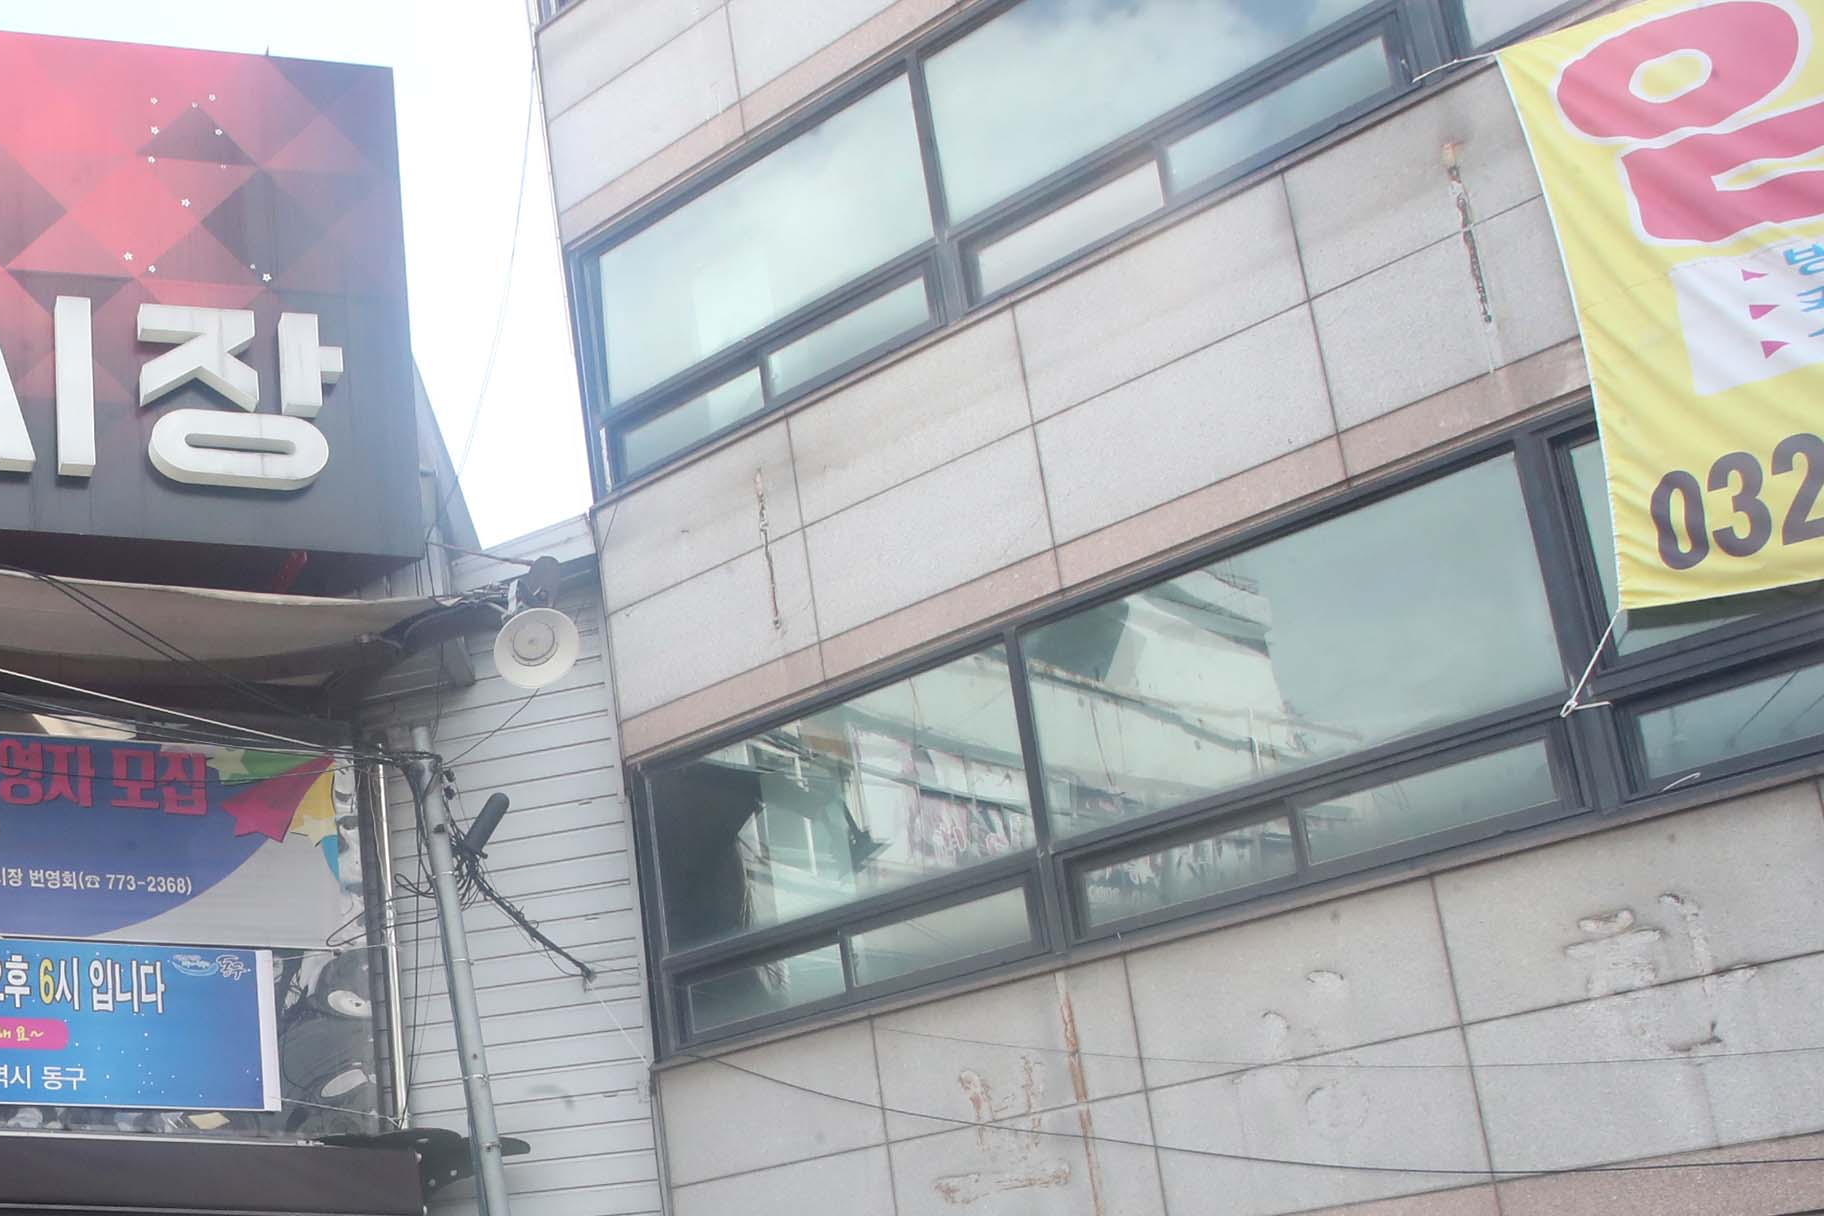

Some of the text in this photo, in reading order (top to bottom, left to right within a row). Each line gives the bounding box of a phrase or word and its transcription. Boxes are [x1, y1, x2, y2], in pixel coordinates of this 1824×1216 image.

[1650, 432, 1824, 570] 032
[112, 747, 208, 815] 모집
[38, 956, 80, 1012] 6시
[88, 959, 166, 1015] 입니다
[41, 1066, 87, 1092] 동구
